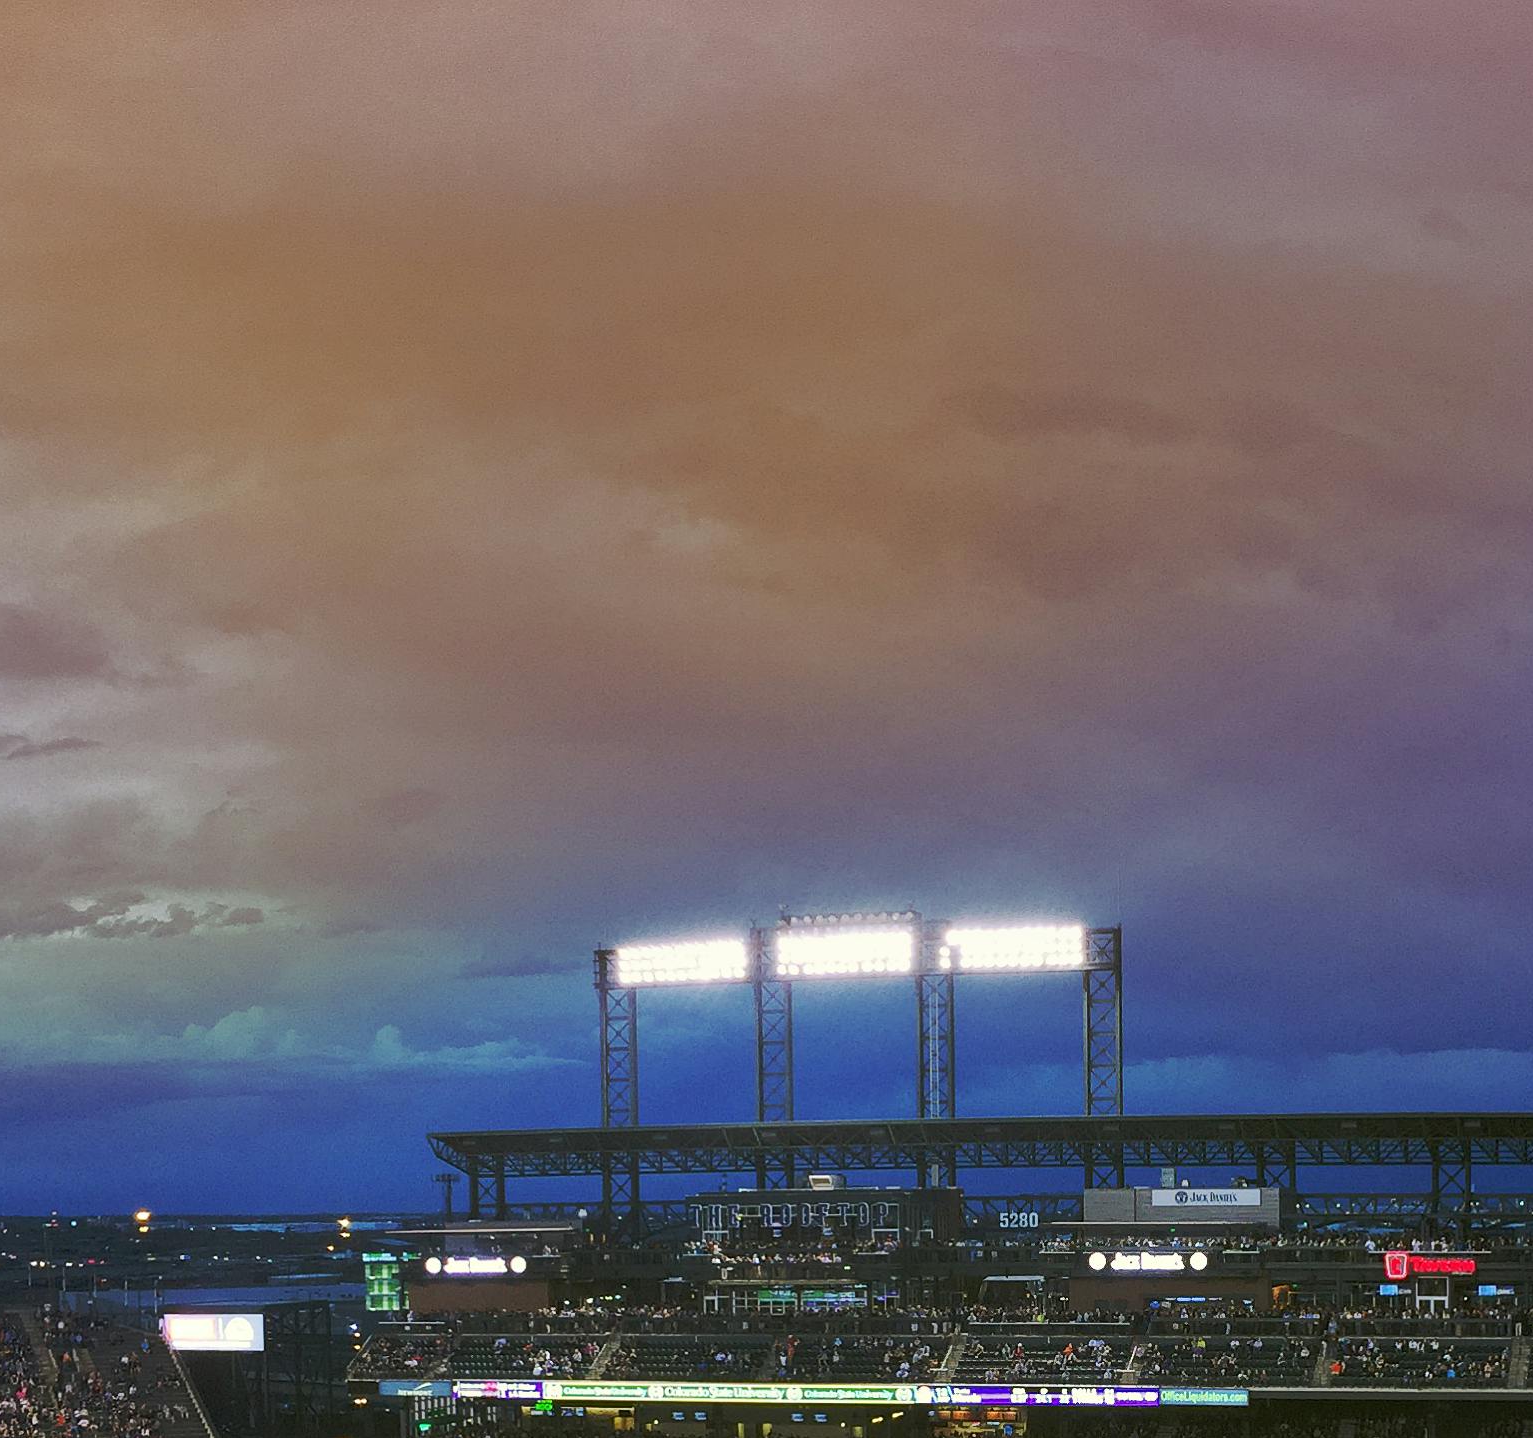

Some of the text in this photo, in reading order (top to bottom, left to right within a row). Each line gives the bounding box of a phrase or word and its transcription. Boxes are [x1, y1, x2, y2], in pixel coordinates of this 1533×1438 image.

[690, 1201, 889, 1228] THE ROOFTOP
[999, 1211, 1039, 1228] 5280
